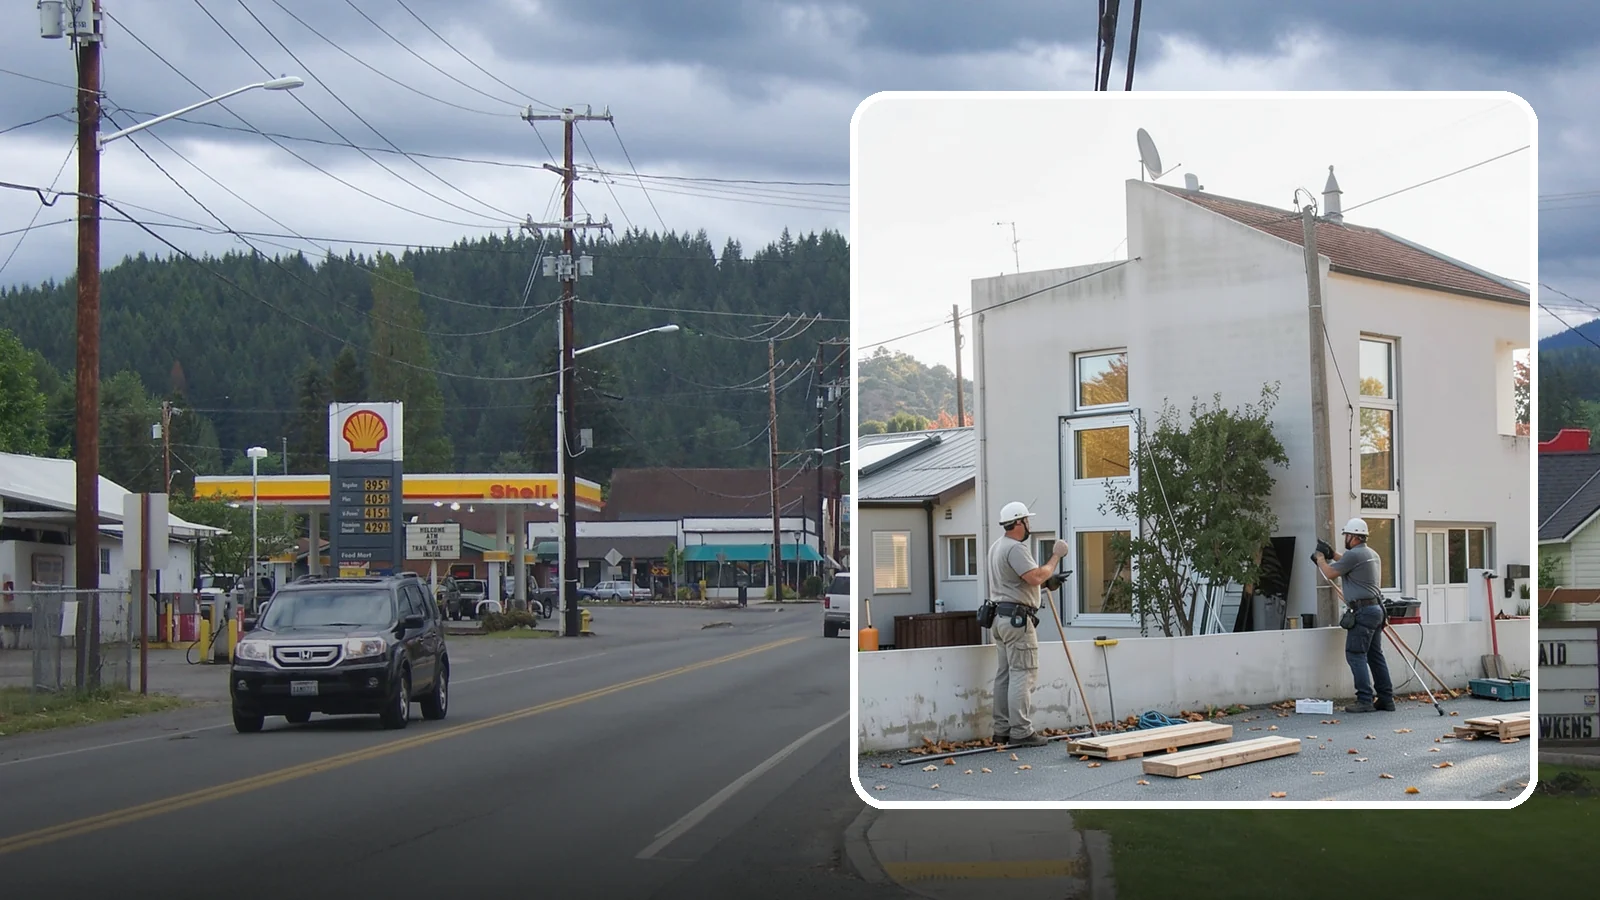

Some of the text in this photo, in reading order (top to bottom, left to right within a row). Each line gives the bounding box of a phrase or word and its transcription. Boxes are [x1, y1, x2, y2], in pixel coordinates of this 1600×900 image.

[366, 480, 384, 490] 395
[490, 484, 547, 499] Shell
[366, 494, 384, 504] 405
[366, 508, 383, 518] 415
[366, 522, 384, 532] 429
[1538, 643, 1567, 665] AID
